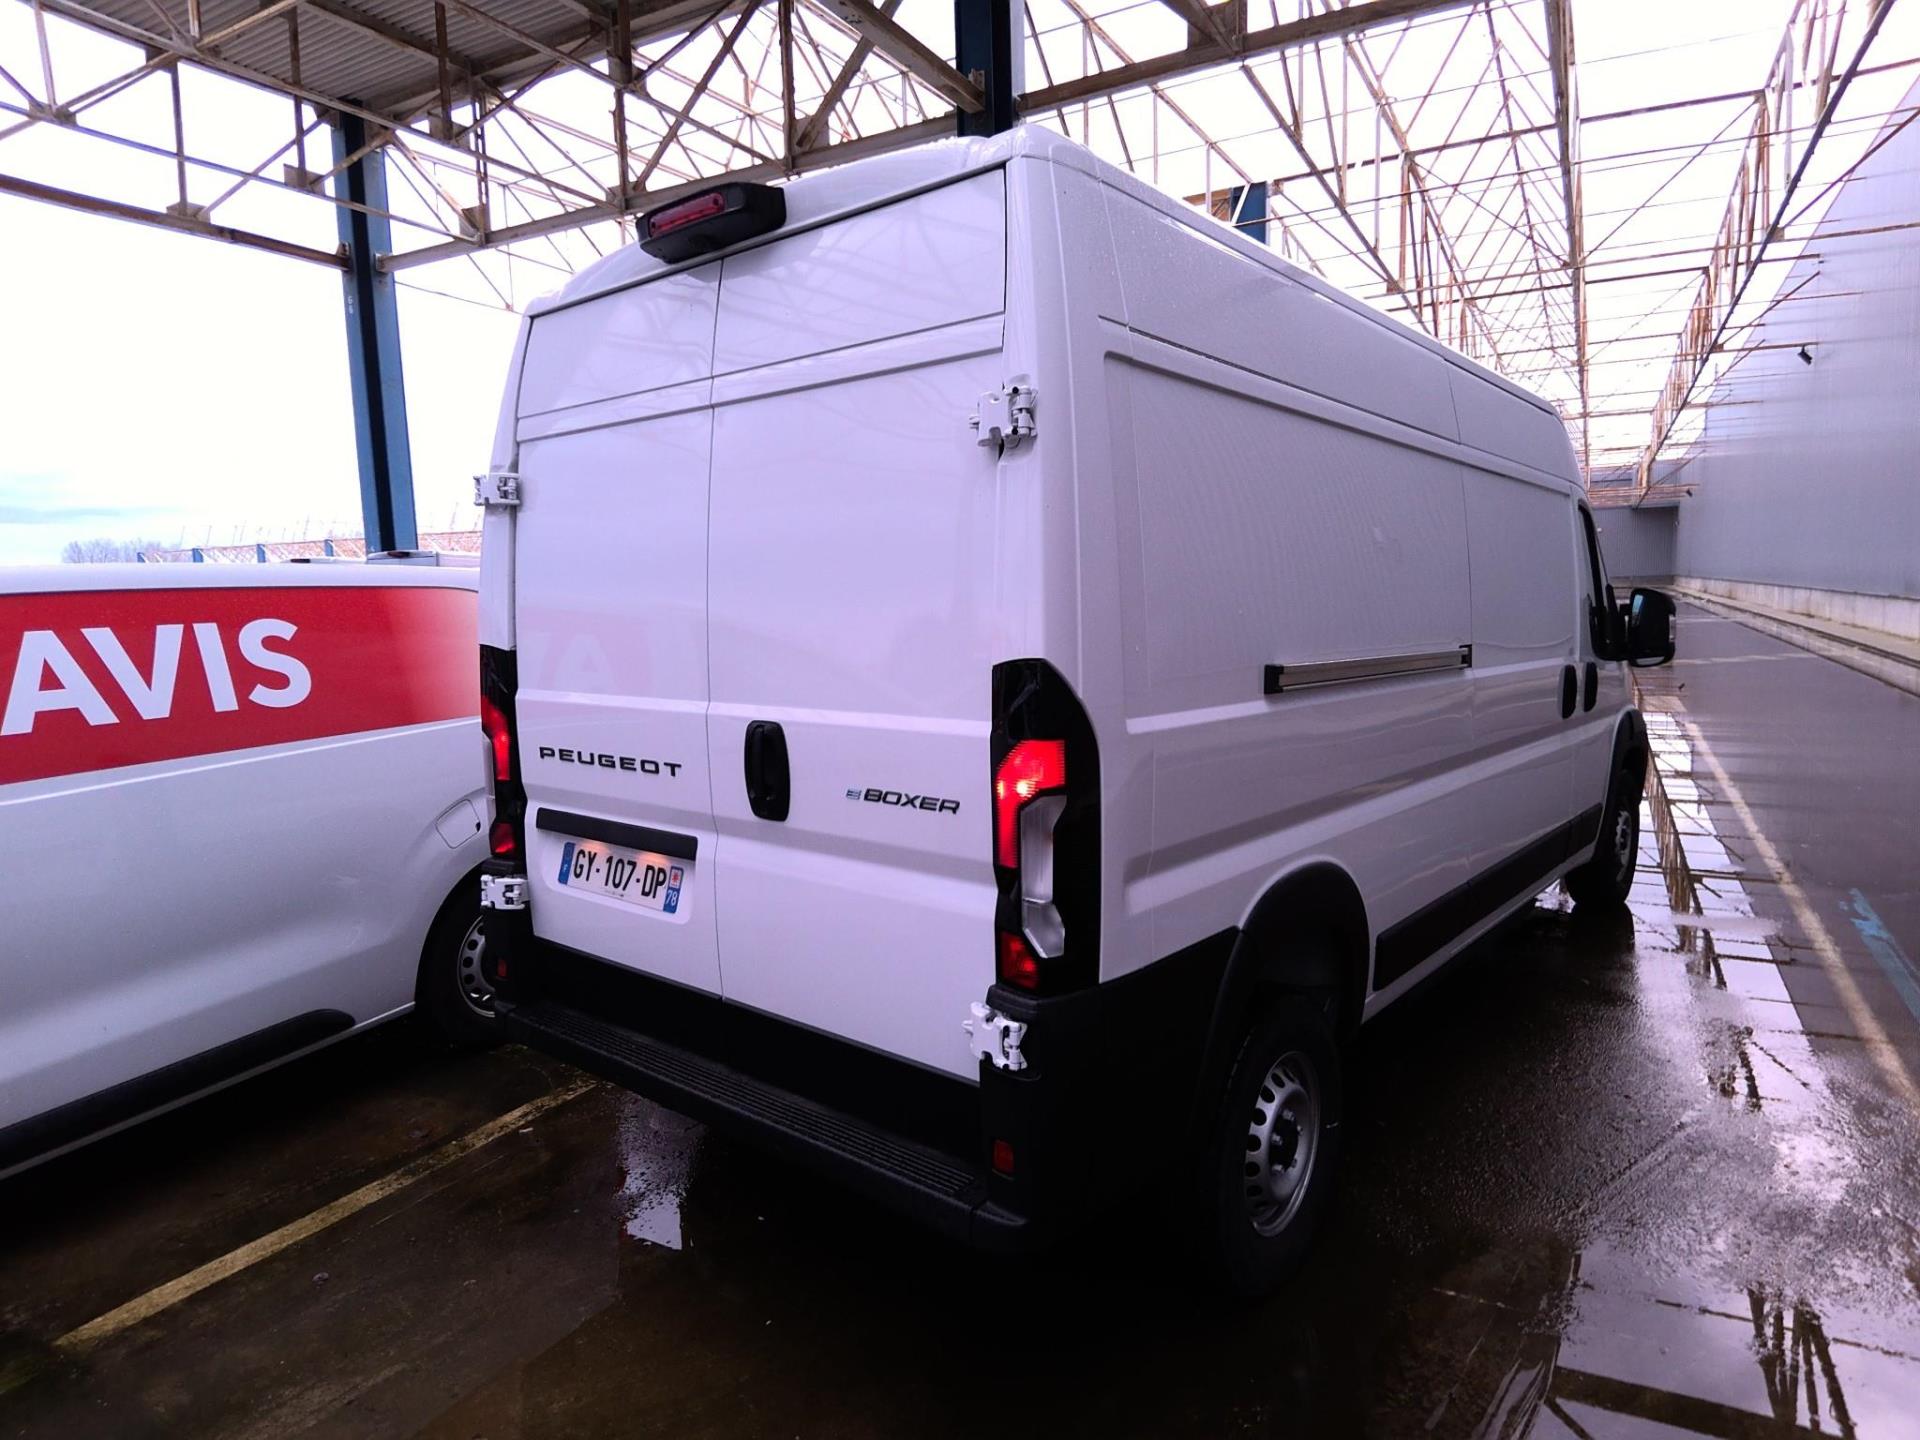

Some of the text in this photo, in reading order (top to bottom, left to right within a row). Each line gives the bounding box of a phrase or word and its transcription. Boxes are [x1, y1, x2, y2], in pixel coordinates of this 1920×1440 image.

[0, 618, 312, 736] AVIS
[539, 746, 682, 777] PEUGEOT
[863, 788, 961, 815] BOXER
[665, 889, 678, 907] 78
